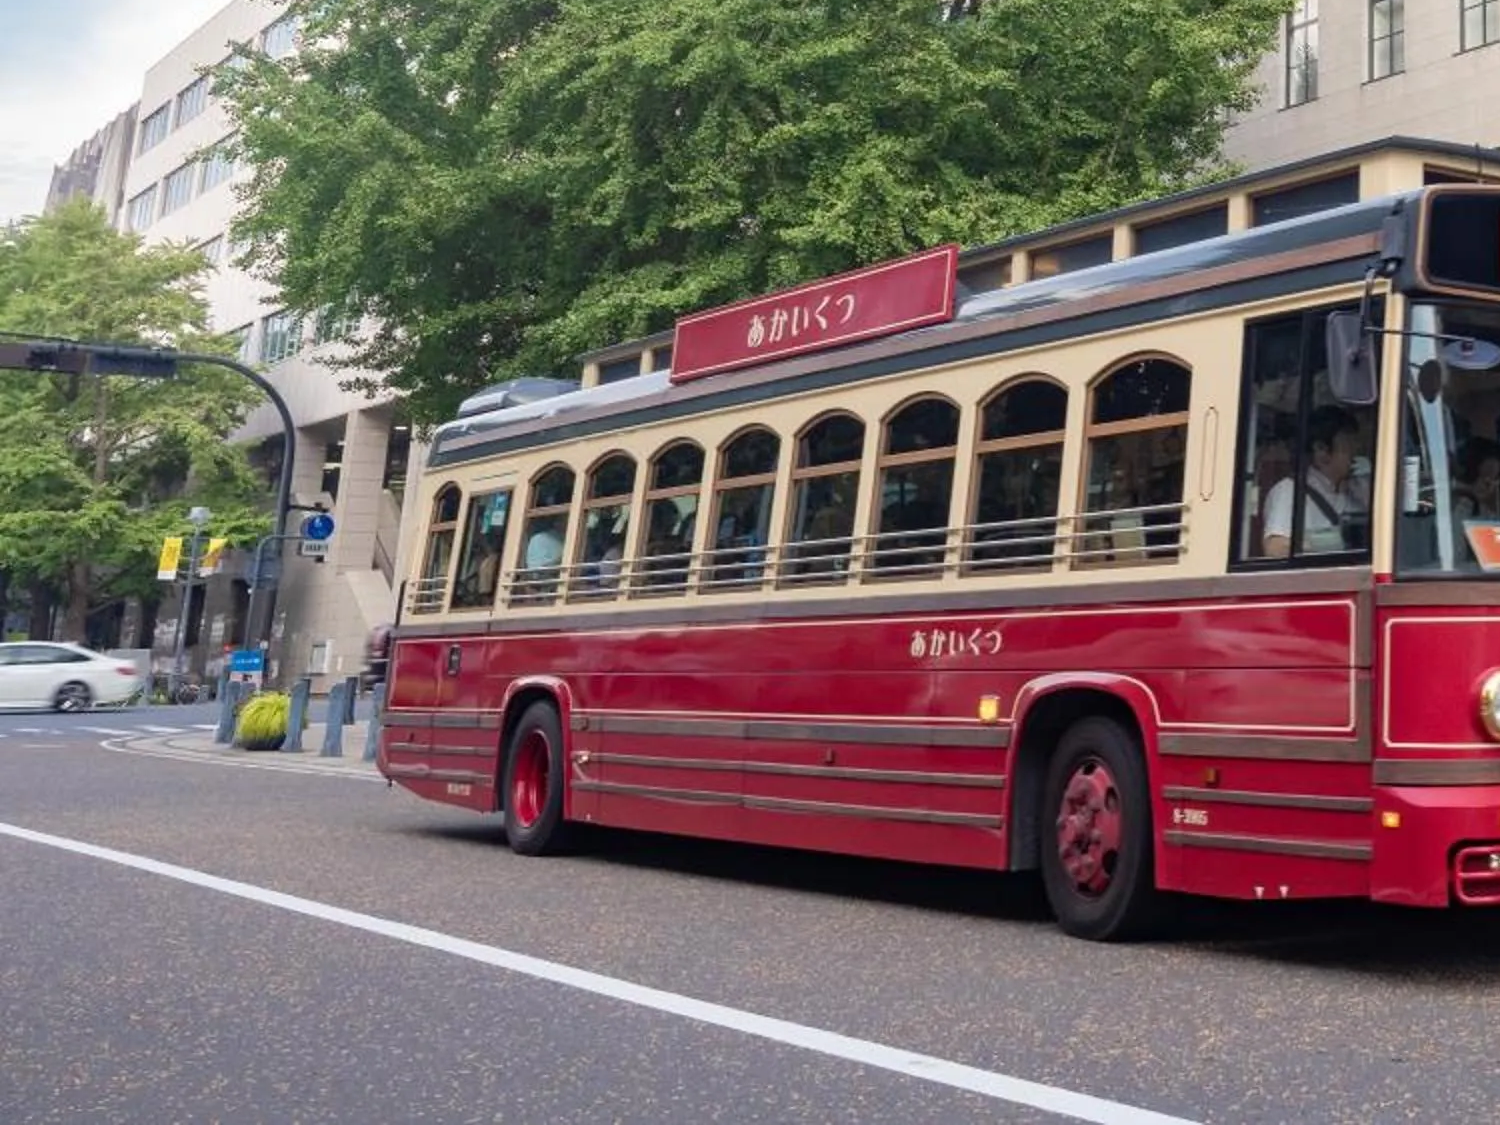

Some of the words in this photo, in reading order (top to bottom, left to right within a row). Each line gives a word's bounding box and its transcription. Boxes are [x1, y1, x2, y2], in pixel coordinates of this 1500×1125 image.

[747, 294, 855, 348] あかいくつ
[910, 628, 1003, 658] あかいくつ
